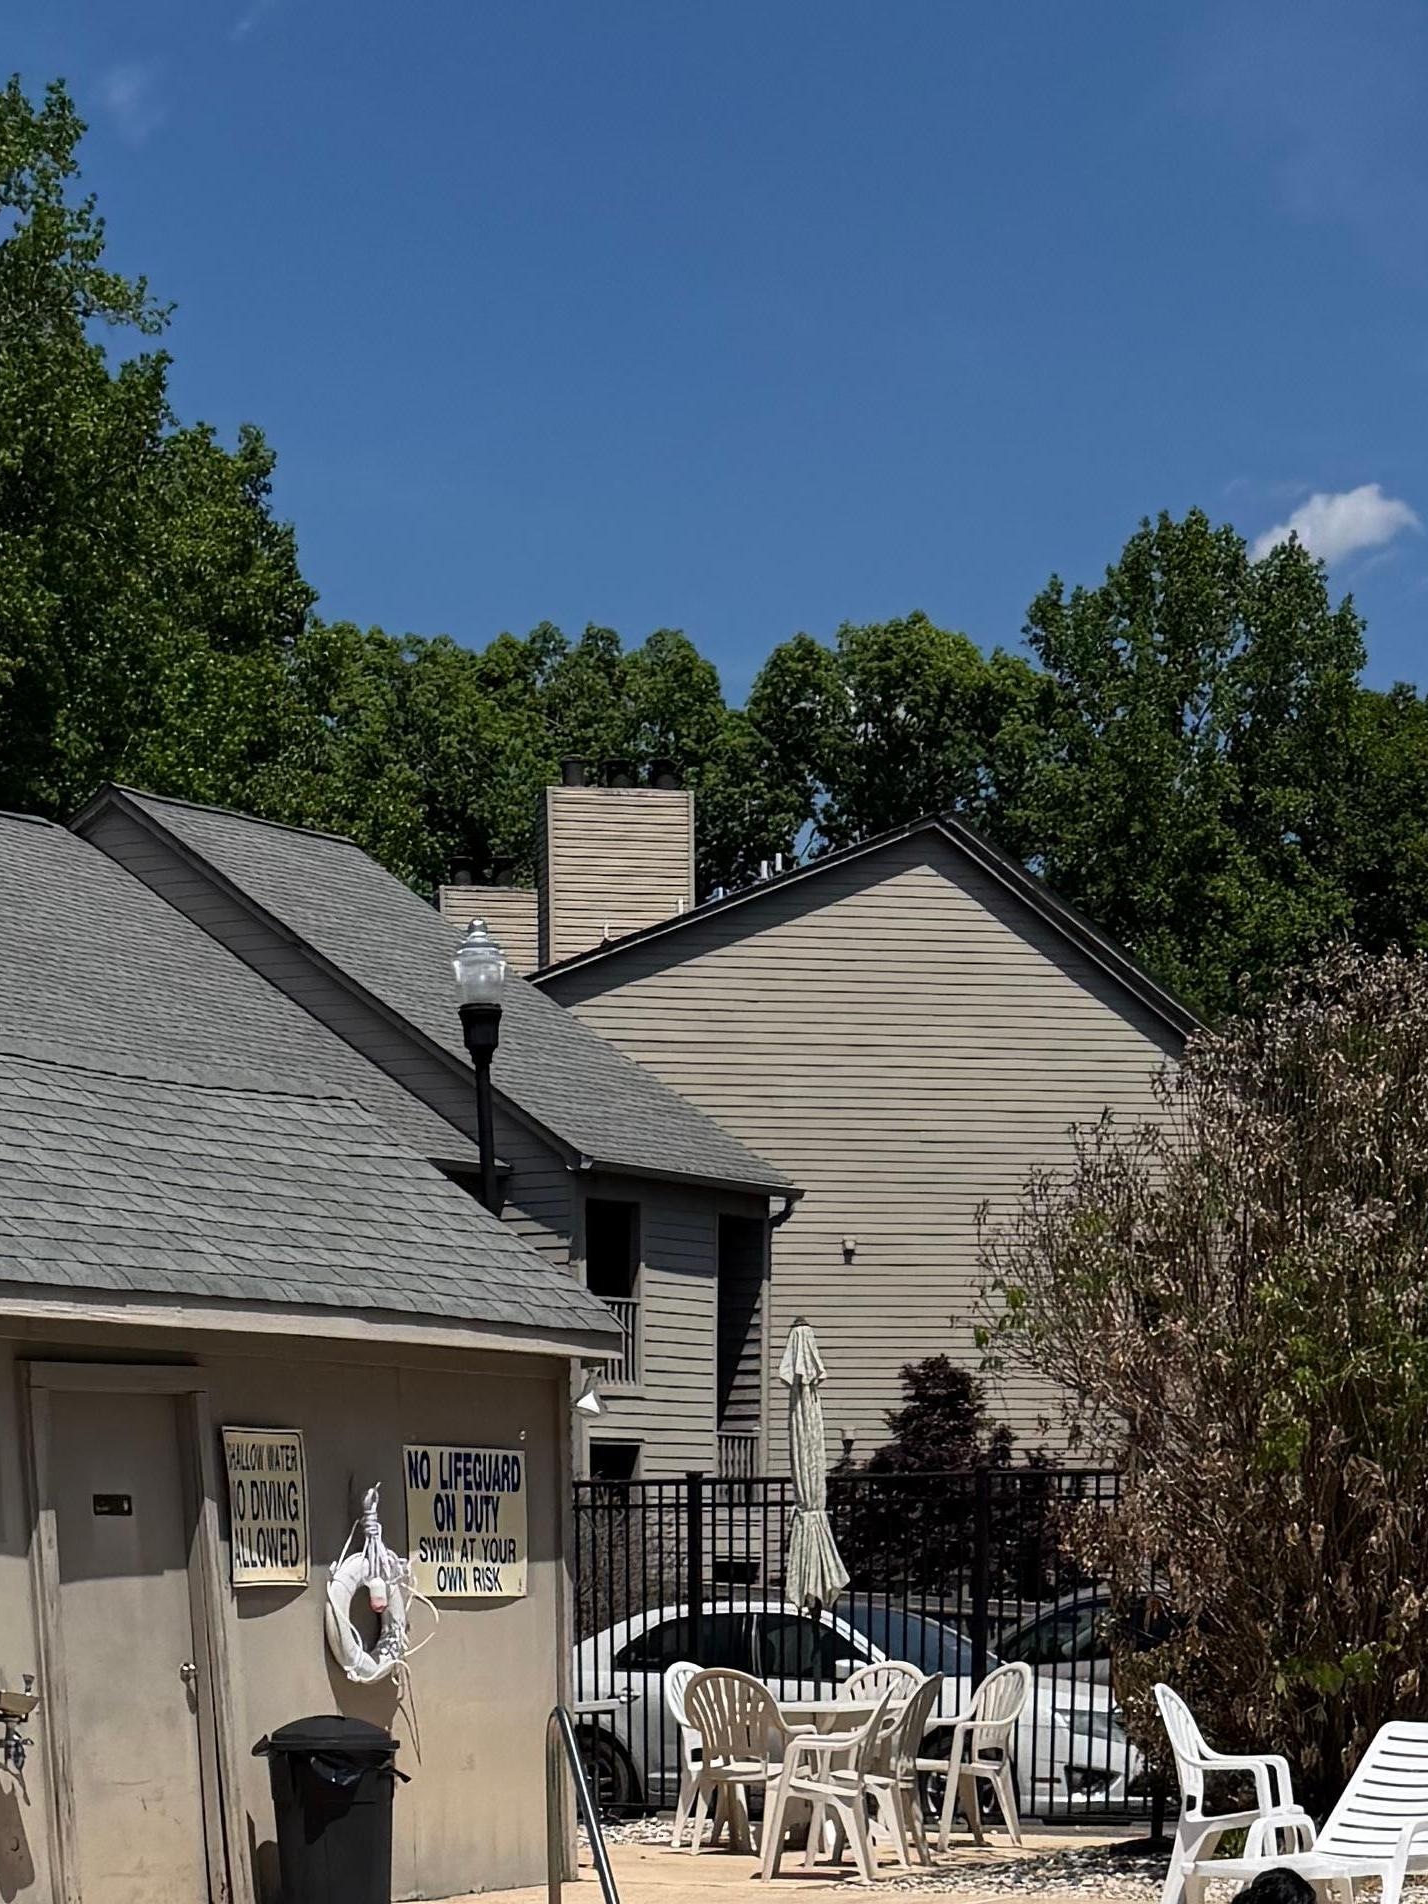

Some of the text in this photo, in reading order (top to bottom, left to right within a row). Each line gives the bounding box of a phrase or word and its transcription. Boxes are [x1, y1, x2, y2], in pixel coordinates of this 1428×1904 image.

[266, 1444, 298, 1471] WATER
[408, 1450, 521, 1492] NO LIFEGUARD
[250, 1480, 299, 1521] DIVING
[434, 1493, 500, 1533] ON DUTY
[235, 1528, 299, 1568] ALLOWED
[419, 1536, 516, 1564] SWIM AT YOUR
[437, 1566, 467, 1592] OWN
[473, 1566, 503, 1592] RISK
